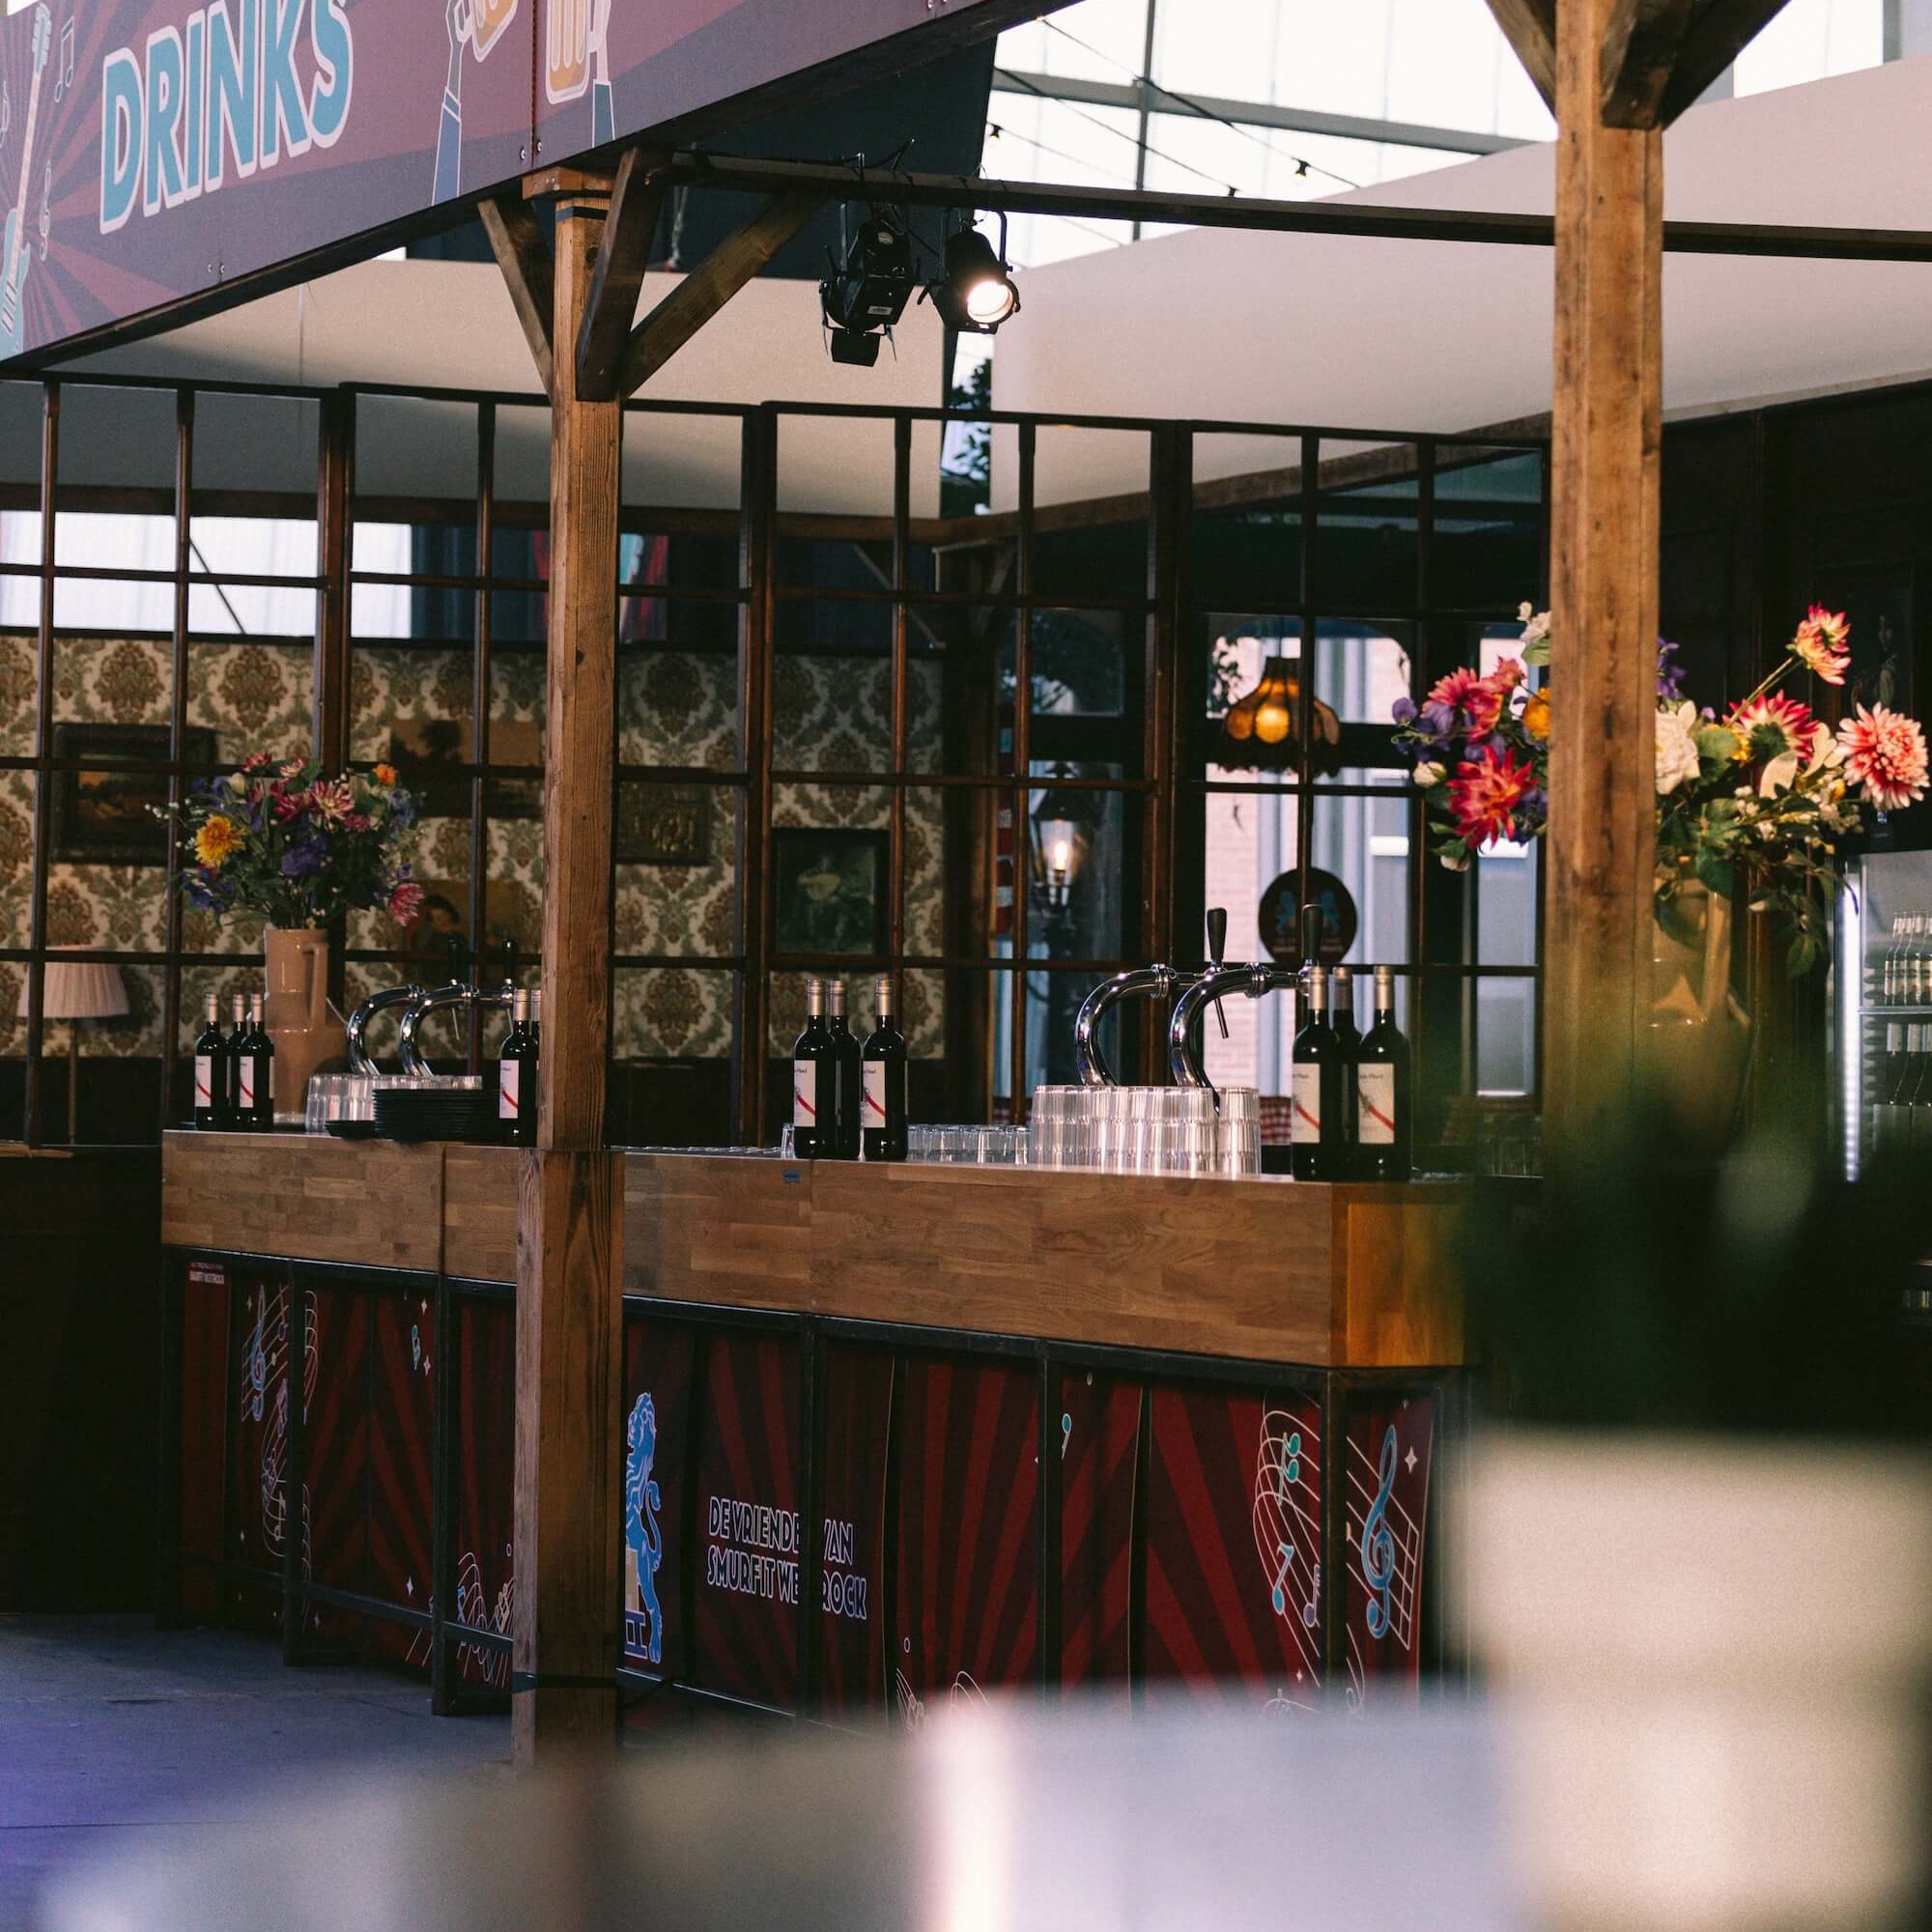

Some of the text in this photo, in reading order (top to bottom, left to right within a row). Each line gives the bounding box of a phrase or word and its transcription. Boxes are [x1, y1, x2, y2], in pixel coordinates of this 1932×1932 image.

[100, 0, 354, 235] DRINKS
[709, 1496, 730, 1540] DE
[731, 1500, 800, 1554] VRIENDE
[707, 1545, 776, 1600] SMURFIT
